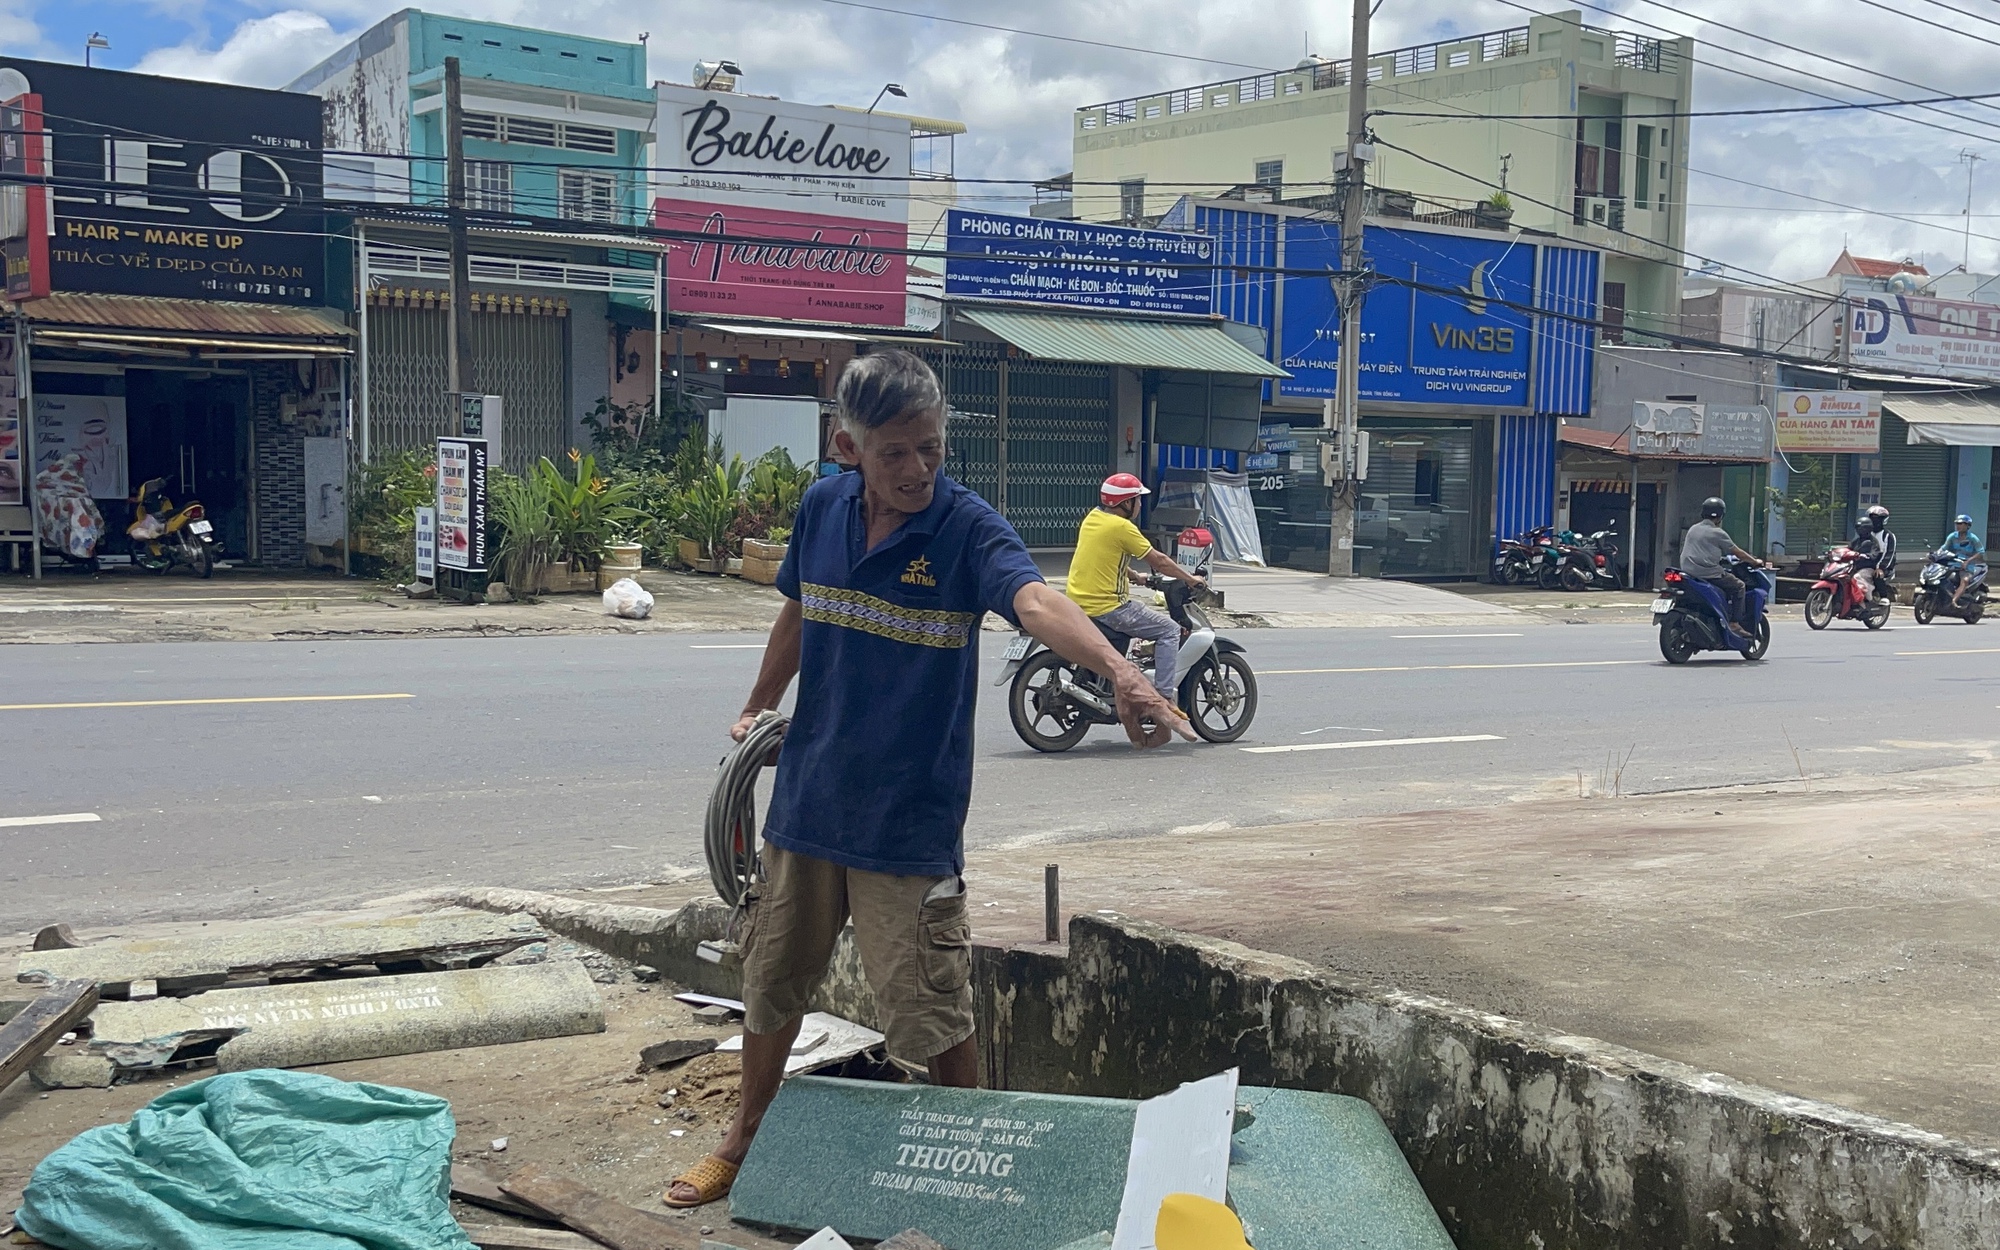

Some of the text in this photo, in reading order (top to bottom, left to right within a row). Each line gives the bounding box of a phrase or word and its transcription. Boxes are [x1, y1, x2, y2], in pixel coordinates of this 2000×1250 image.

[682, 100, 890, 174] Babie love
[841, 195, 865, 206] BABIE
[866, 197, 887, 208] LOVE
[66, 222, 244, 250] HAIR MAKE UP
[961, 215, 1011, 236] PHÒNG
[1057, 228, 1079, 247] TRỊ
[1084, 231, 1093, 245] Y
[1096, 232, 1124, 250] HỌC
[1147, 234, 1196, 256] TRUYỀN
[53, 250, 115, 267] THÁC
[211, 257, 257, 276] CỦA
[261, 264, 304, 281] BẠN
[1037, 275, 1063, 291] MẠCH
[1068, 276, 1080, 291] KÊ
[1081, 280, 1100, 292] ĐƠN
[1105, 277, 1124, 294] BỐC
[1126, 280, 1156, 297] THUỐC
[1940, 307, 1979, 336] AN
[1315, 329, 1376, 344] VINST
[1430, 321, 1515, 353] VIN3S
[1308, 357, 1339, 371] HÀNG
[1378, 361, 1403, 376] ĐIỆN
[1412, 364, 1527, 383] TRUNG TÂM TRẢI NGHIỆM
[1425, 380, 1513, 395] DỊCH VỤ VINGROUP
[1820, 401, 1862, 411] RIMULA
[1800, 419, 1828, 429] HÀNG
[1830, 419, 1847, 429] AN
[1850, 417, 1875, 429] TÂM
[1267, 439, 1297, 451] VINFAST
[475, 448, 485, 466] MỸ
[1260, 475, 1284, 491] 205
[476, 532, 485, 564] PHUN
[899, 1121, 924, 1138] GIẤY
[924, 1124, 946, 1139] DÁN
[948, 1127, 984, 1143] TƯỜNG
[956, 1115, 974, 1129] CAO
[1012, 1119, 1026, 1130] 3D
[896, 1143, 1014, 1178] THƯỢNG
[913, 1176, 976, 1198] 0977002618
